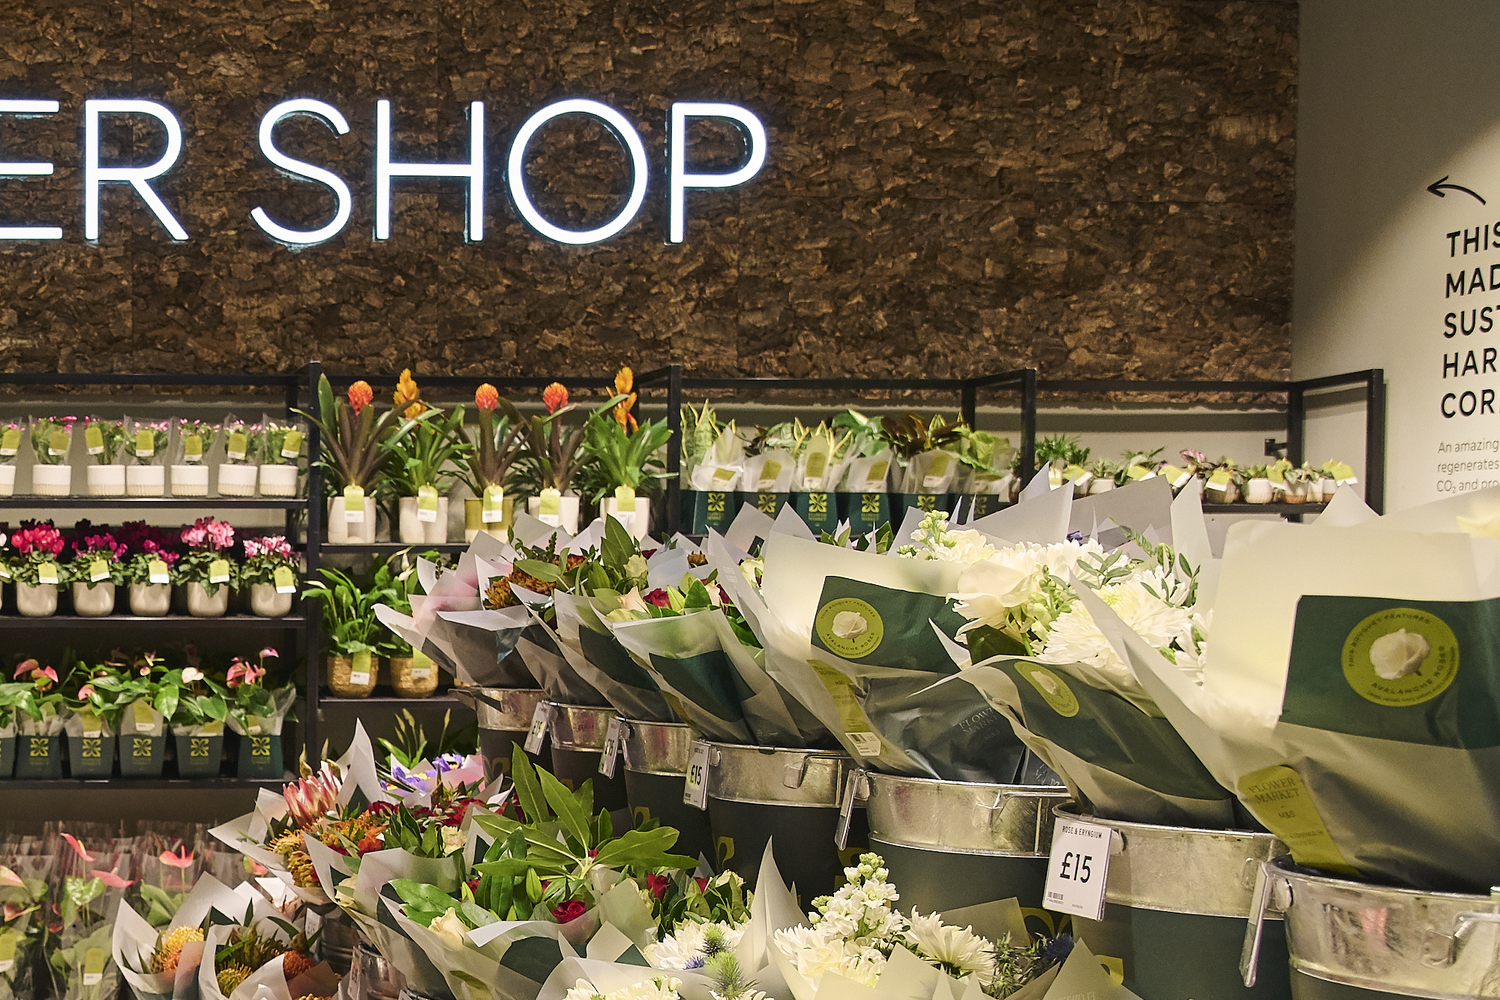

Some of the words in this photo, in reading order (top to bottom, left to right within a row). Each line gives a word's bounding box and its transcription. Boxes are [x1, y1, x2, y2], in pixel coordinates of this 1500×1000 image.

[250, 98, 767, 246] SHOP
[1446, 220, 1500, 258] THIS
[1437, 441, 1452, 454] An
[1454, 437, 1499, 453] amazing
[1437, 458, 1499, 476] regenerates
[1458, 478, 1478, 492] and
[690, 764, 703, 786] £15
[1247, 777, 1297, 794] FLOWER
[1255, 789, 1299, 804] MARKET
[1062, 825, 1074, 835] ROSE
[1078, 828, 1103, 840] ERYNGIUM
[1059, 851, 1093, 883] £15
